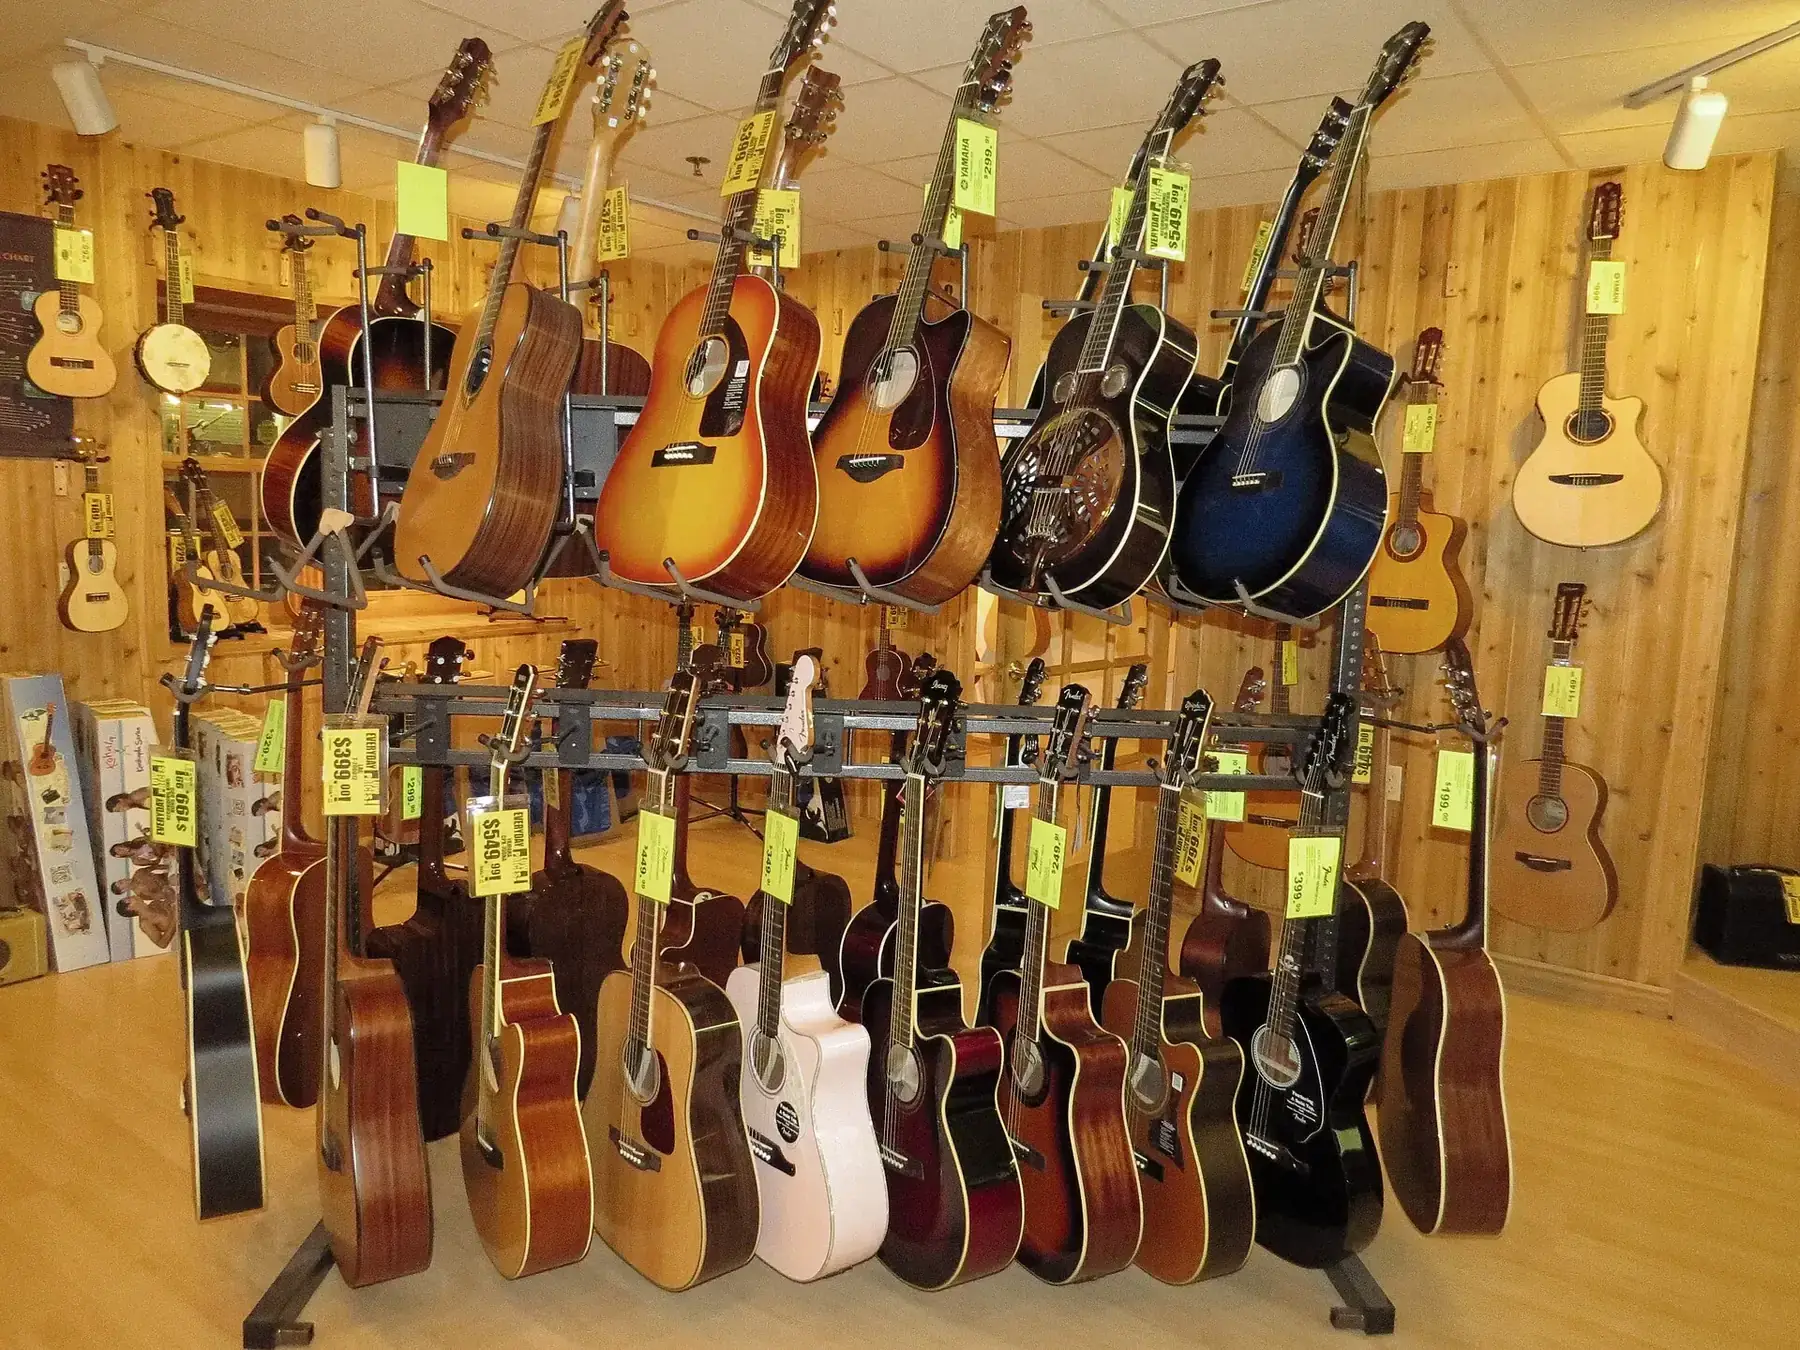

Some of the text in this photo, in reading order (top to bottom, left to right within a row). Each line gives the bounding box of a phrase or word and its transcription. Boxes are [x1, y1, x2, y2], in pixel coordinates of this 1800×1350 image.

[960, 138, 970, 177] YAMAHA
[1168, 183, 1184, 249] $549.99!
[1063, 688, 1083, 700] Fender
[799, 710, 807, 743] Fender
[365, 732, 376, 774] EVERYDAY
[1325, 733, 1337, 764] Fender
[333, 737, 352, 802] $399.00!
[175, 770, 190, 832] $199.99!
[407, 777, 416, 813] $299.99
[1439, 781, 1452, 822] $199.00
[156, 797, 165, 836] EVERYDAY
[513, 811, 524, 851] EVERYDAY
[483, 818, 501, 881] $549.99!
[1183, 813, 1202, 873] $799.00!
[1322, 865, 1332, 888] Fender
